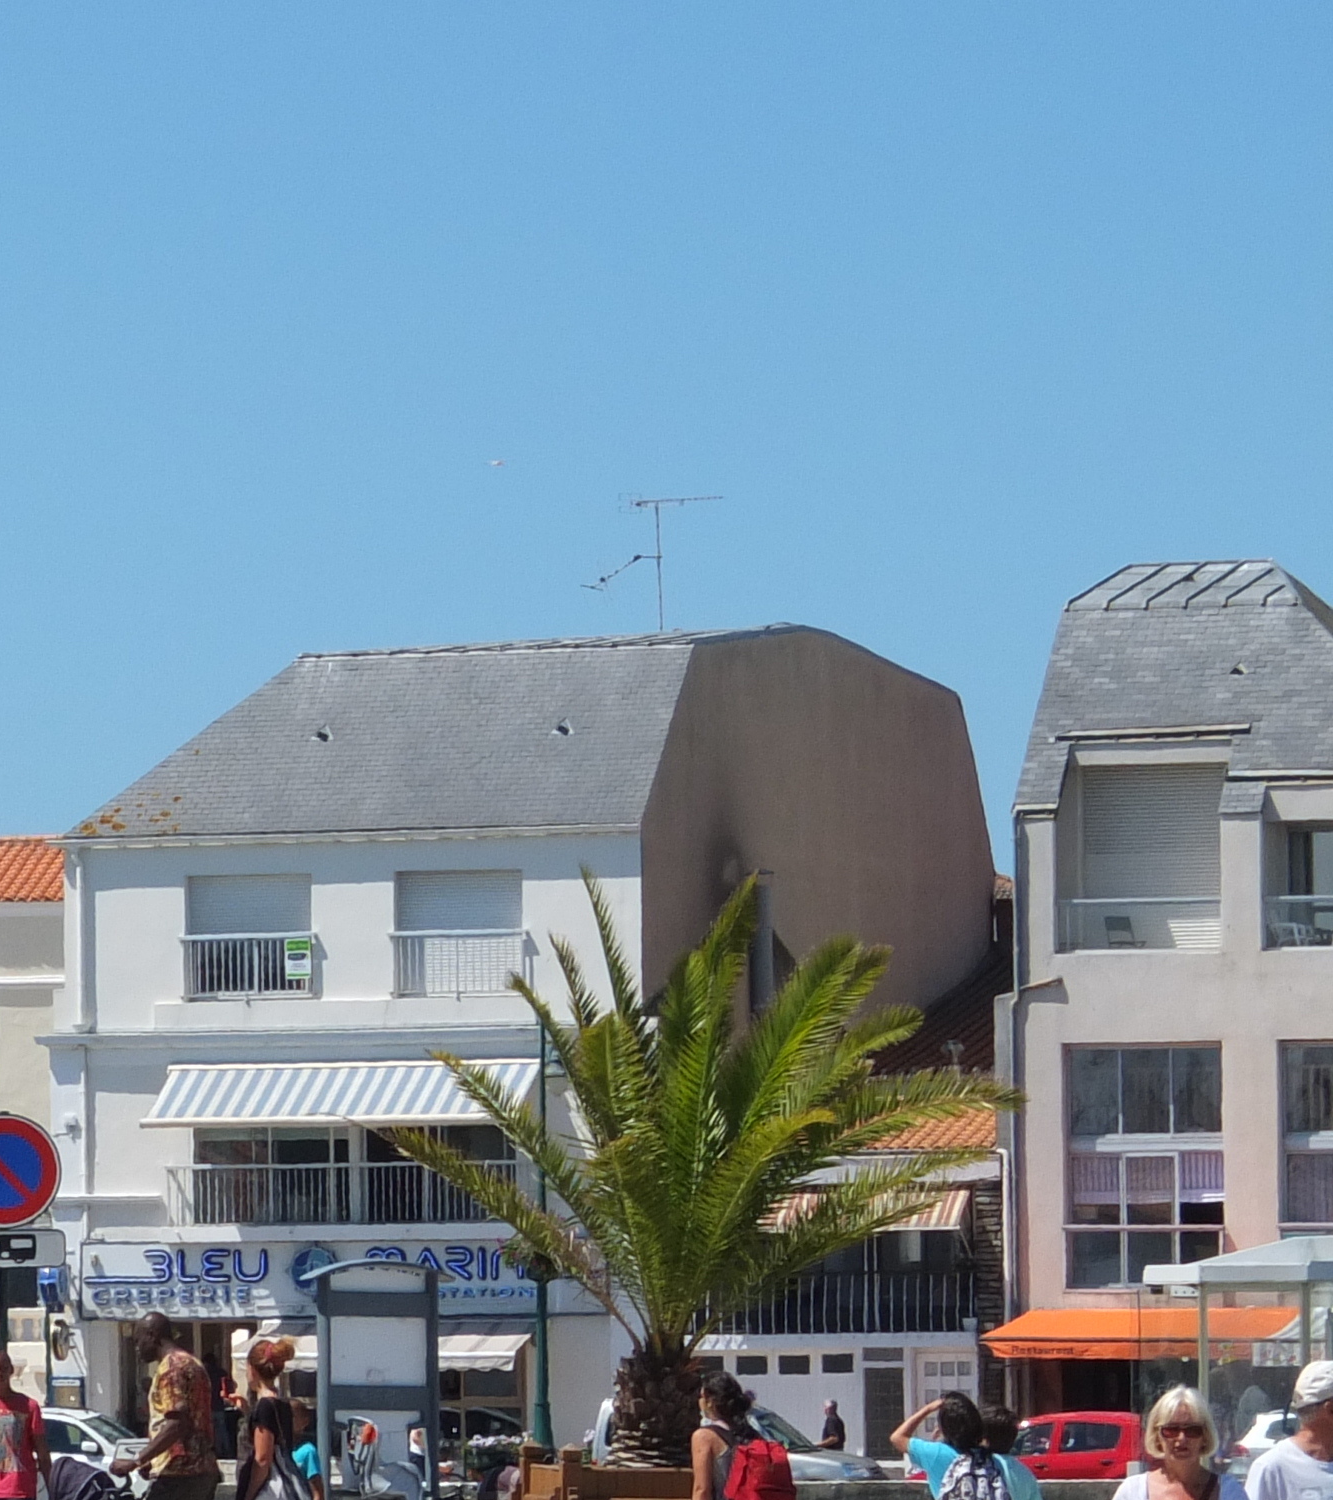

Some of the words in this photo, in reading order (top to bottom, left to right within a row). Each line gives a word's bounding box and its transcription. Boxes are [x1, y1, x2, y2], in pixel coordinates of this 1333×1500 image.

[84, 1249, 270, 1285] BLEU
[365, 1246, 527, 1282] MARIN
[438, 1286, 536, 1299] STATION
[1011, 1345, 1074, 1355] Restaurant
